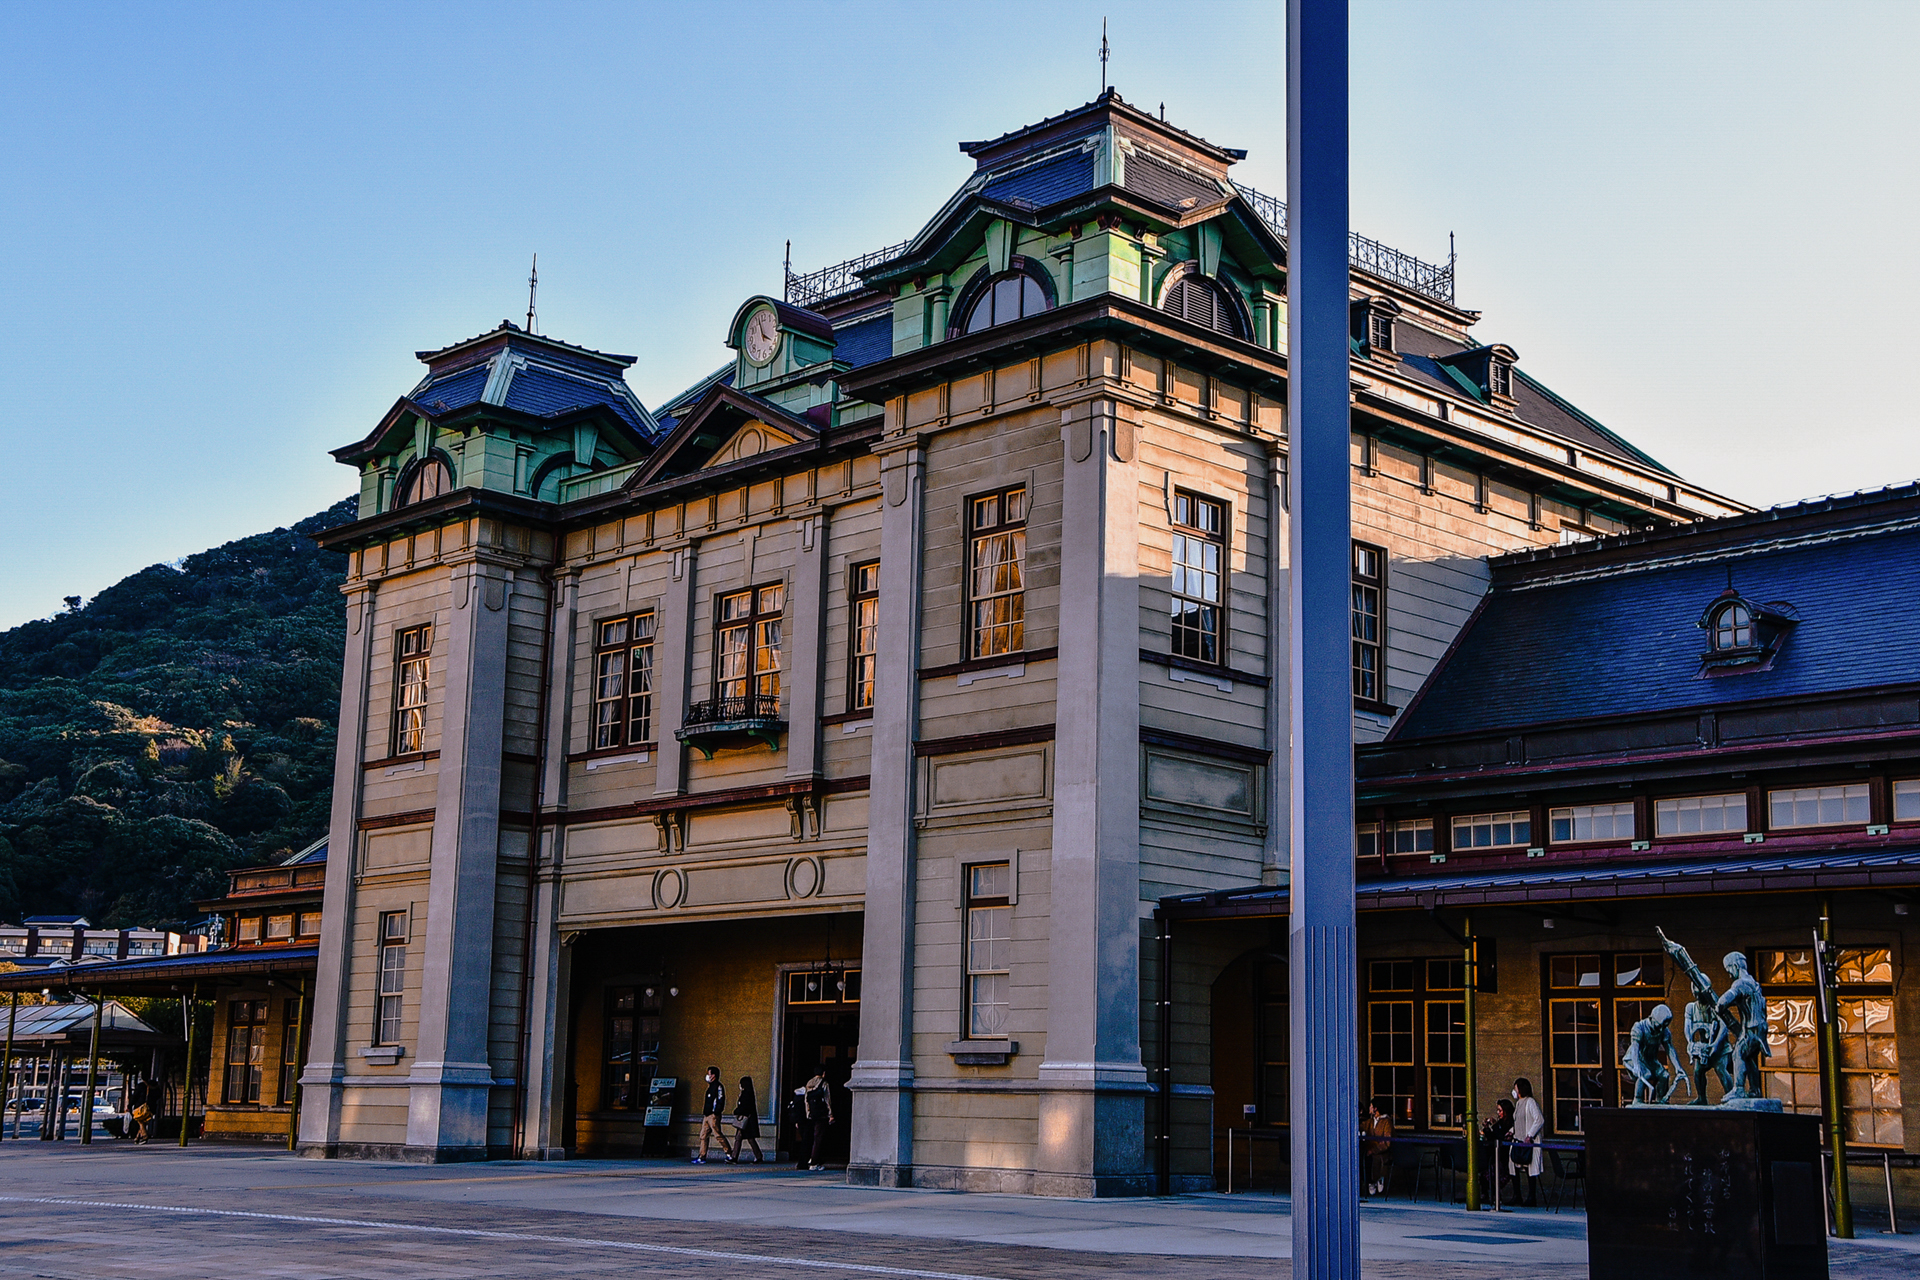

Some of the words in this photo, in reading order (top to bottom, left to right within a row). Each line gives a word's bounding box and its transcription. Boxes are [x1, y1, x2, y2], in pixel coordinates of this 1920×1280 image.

[761, 313, 766, 322] 12
[750, 325, 757, 335] 10
[749, 337, 754, 346] 9
[752, 344, 756, 353] 8
[757, 349, 761, 358] 7
[762, 349, 767, 358] 6
